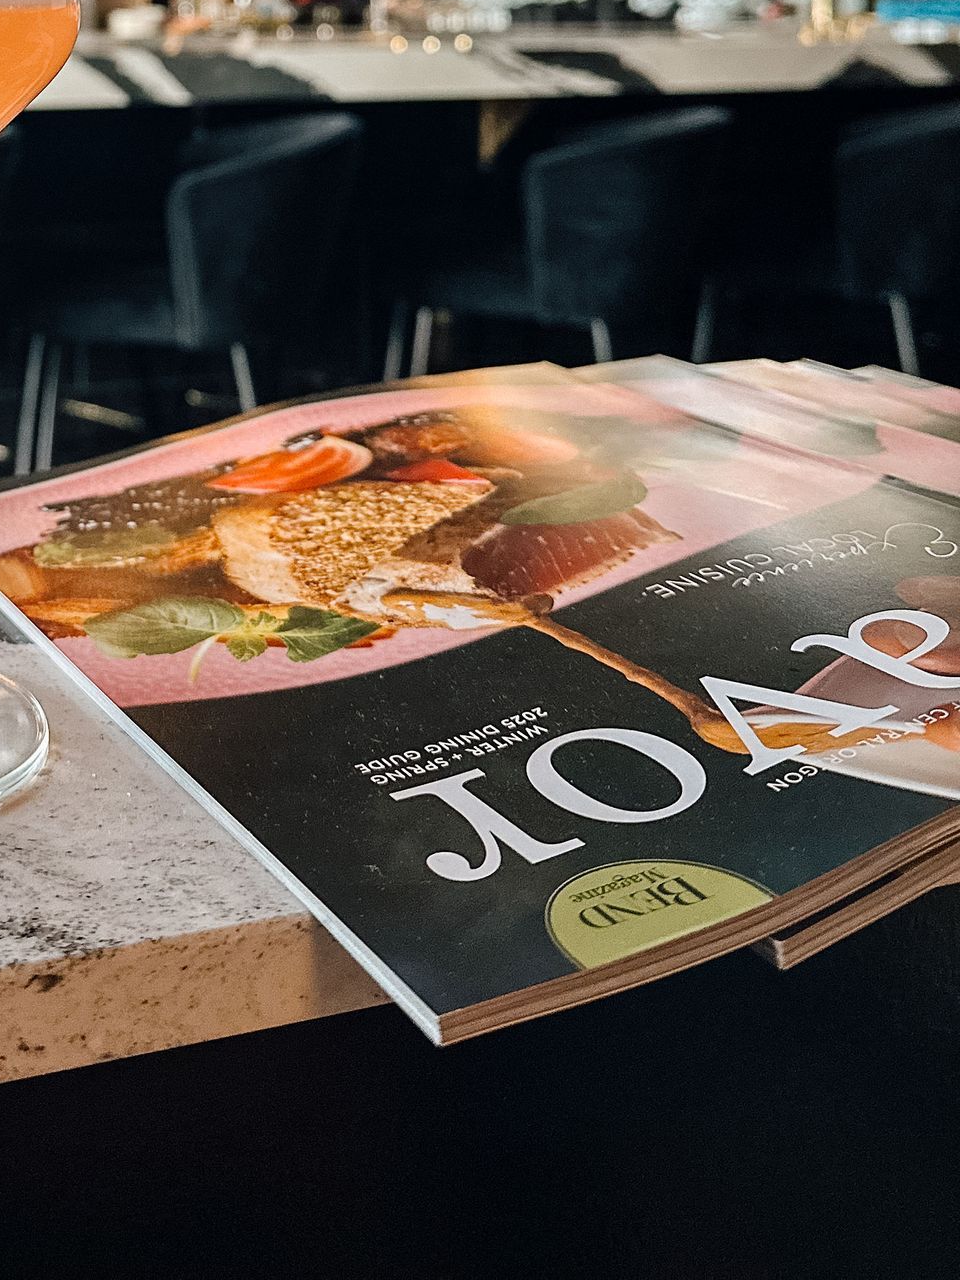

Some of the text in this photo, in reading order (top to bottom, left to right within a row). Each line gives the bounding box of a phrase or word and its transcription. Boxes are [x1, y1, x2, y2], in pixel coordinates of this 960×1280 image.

[731, 522, 959, 588] Experience
[771, 529, 878, 556] LOCAL
[353, 706, 549, 775] 2025 DINING GUIDE
[464, 724, 549, 757] WINTER
[369, 756, 450, 786] SPRING
[766, 748, 857, 793] ORGON
[568, 866, 671, 904] Magazine
[578, 875, 714, 929] BEND
